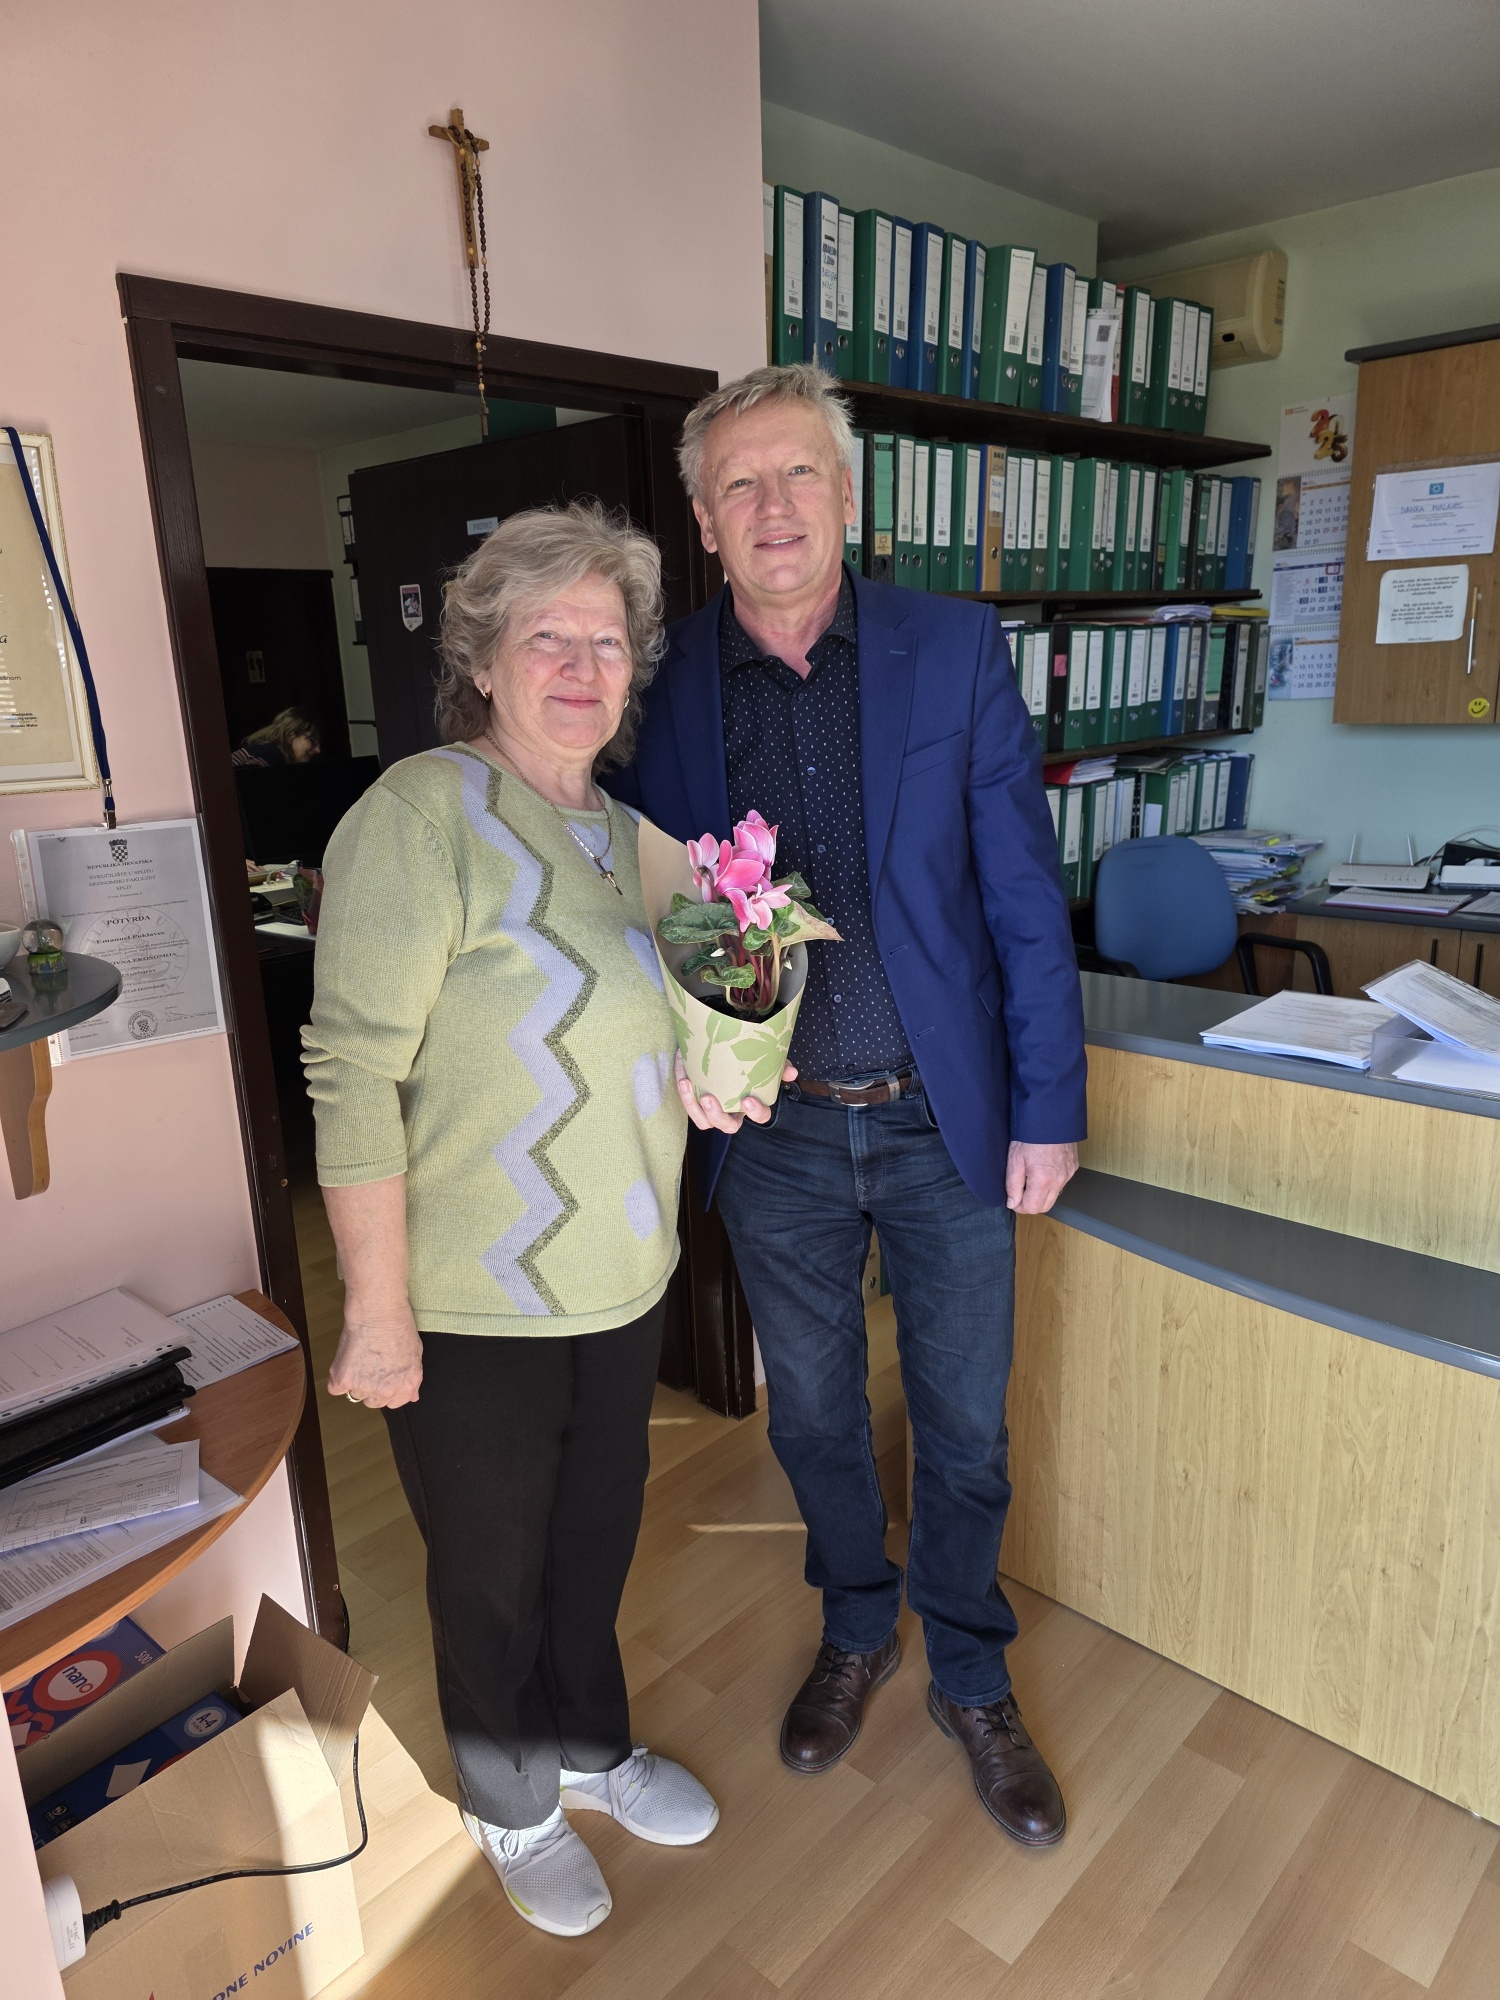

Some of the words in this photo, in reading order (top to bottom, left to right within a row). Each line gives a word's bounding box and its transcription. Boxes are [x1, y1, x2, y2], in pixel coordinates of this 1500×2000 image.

[88, 878, 126, 887] EKONOMSKI
[126, 875, 157, 884] FAKULTET
[89, 870, 128, 880] SVEUČILIŠTE
[106, 914, 151, 926] POTVRDA
[96, 935, 131, 944] Emanuel
[132, 930, 166, 940] Puklavec
[132, 952, 178, 962] EKONOMIJA
[134, 1650, 154, 1665] 500
[62, 1665, 94, 1694] nano
[196, 1712, 218, 1729] A-4
[253, 1922, 314, 1977] NOVINE
